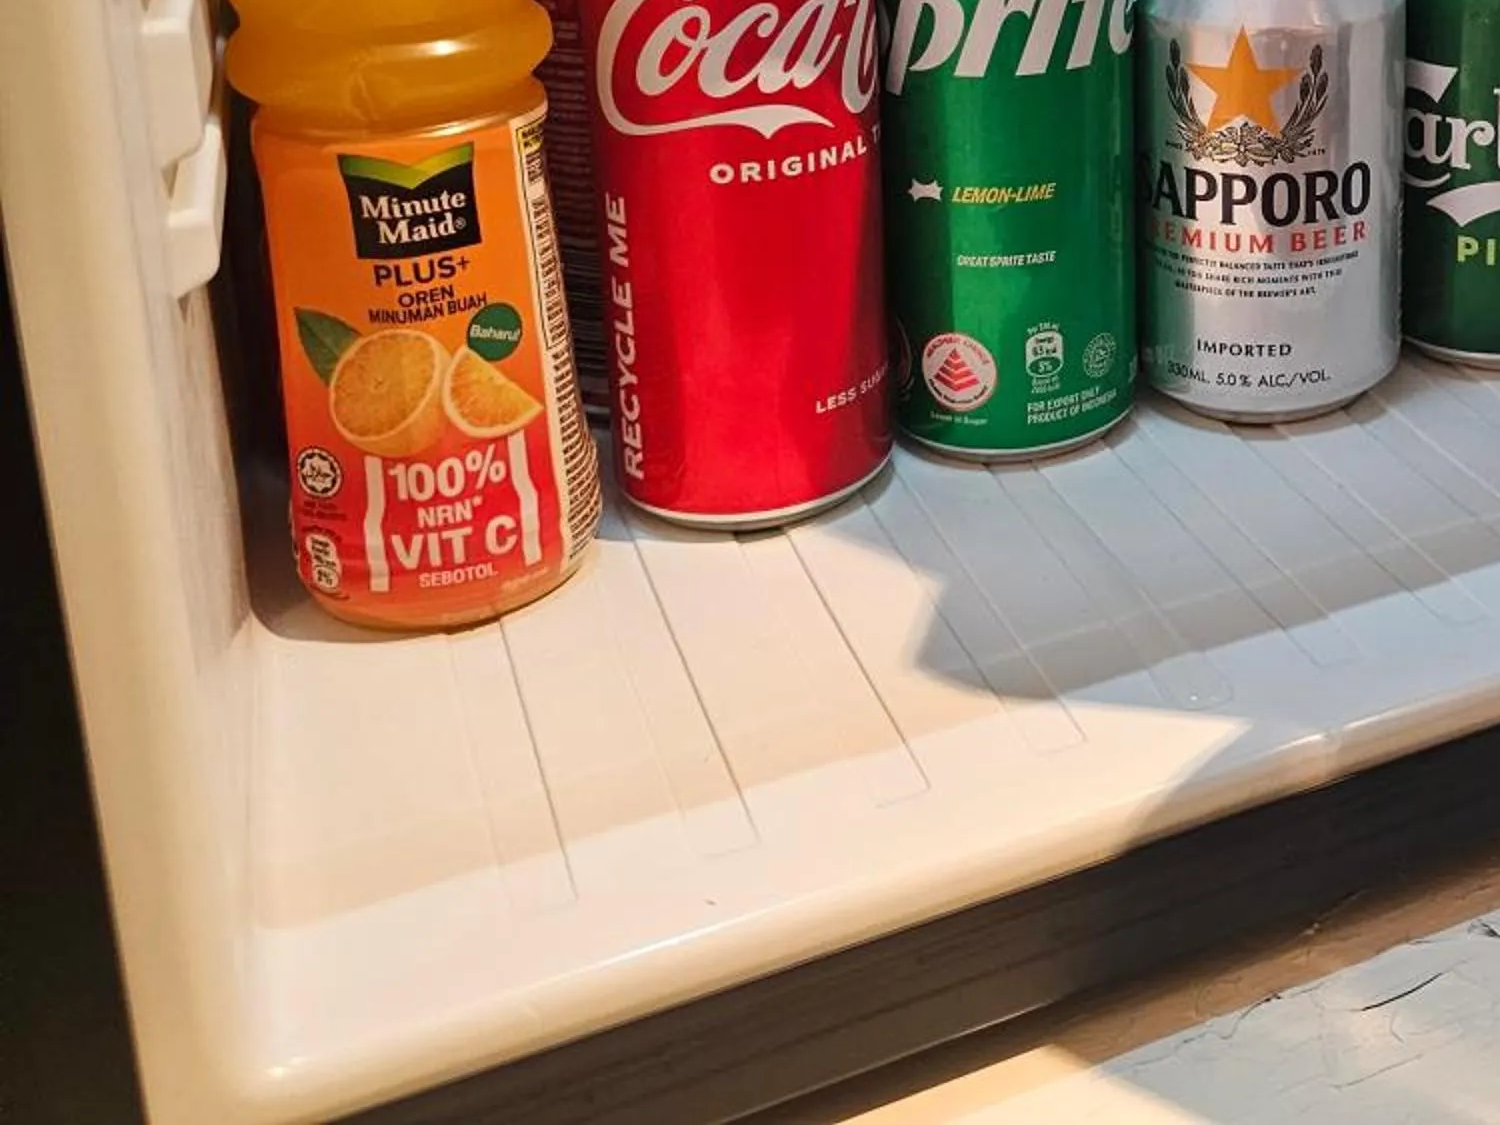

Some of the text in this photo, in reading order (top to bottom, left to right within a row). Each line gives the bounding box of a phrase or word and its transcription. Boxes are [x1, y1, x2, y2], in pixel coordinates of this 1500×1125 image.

[710, 135, 868, 184] ORIGINAL
[359, 189, 467, 219] Minute
[952, 182, 1056, 204] LEMON-LIME
[1142, 160, 1371, 228] APPORO
[1150, 218, 1367, 254] EMIUM BEER
[1026, 250, 1057, 265] TASTE
[368, 291, 488, 325] MINUMAN BUAH
[398, 284, 455, 308] OREN
[605, 191, 645, 480] RECYCLE ME
[1196, 338, 1292, 358] IMPORTED
[816, 386, 857, 414] LESS
[1027, 408, 1068, 425] PRODUCT
[389, 442, 507, 503] 100%
[390, 526, 475, 572] VIT
[484, 514, 519, 557] C
[419, 561, 500, 590] SEBOTOL
